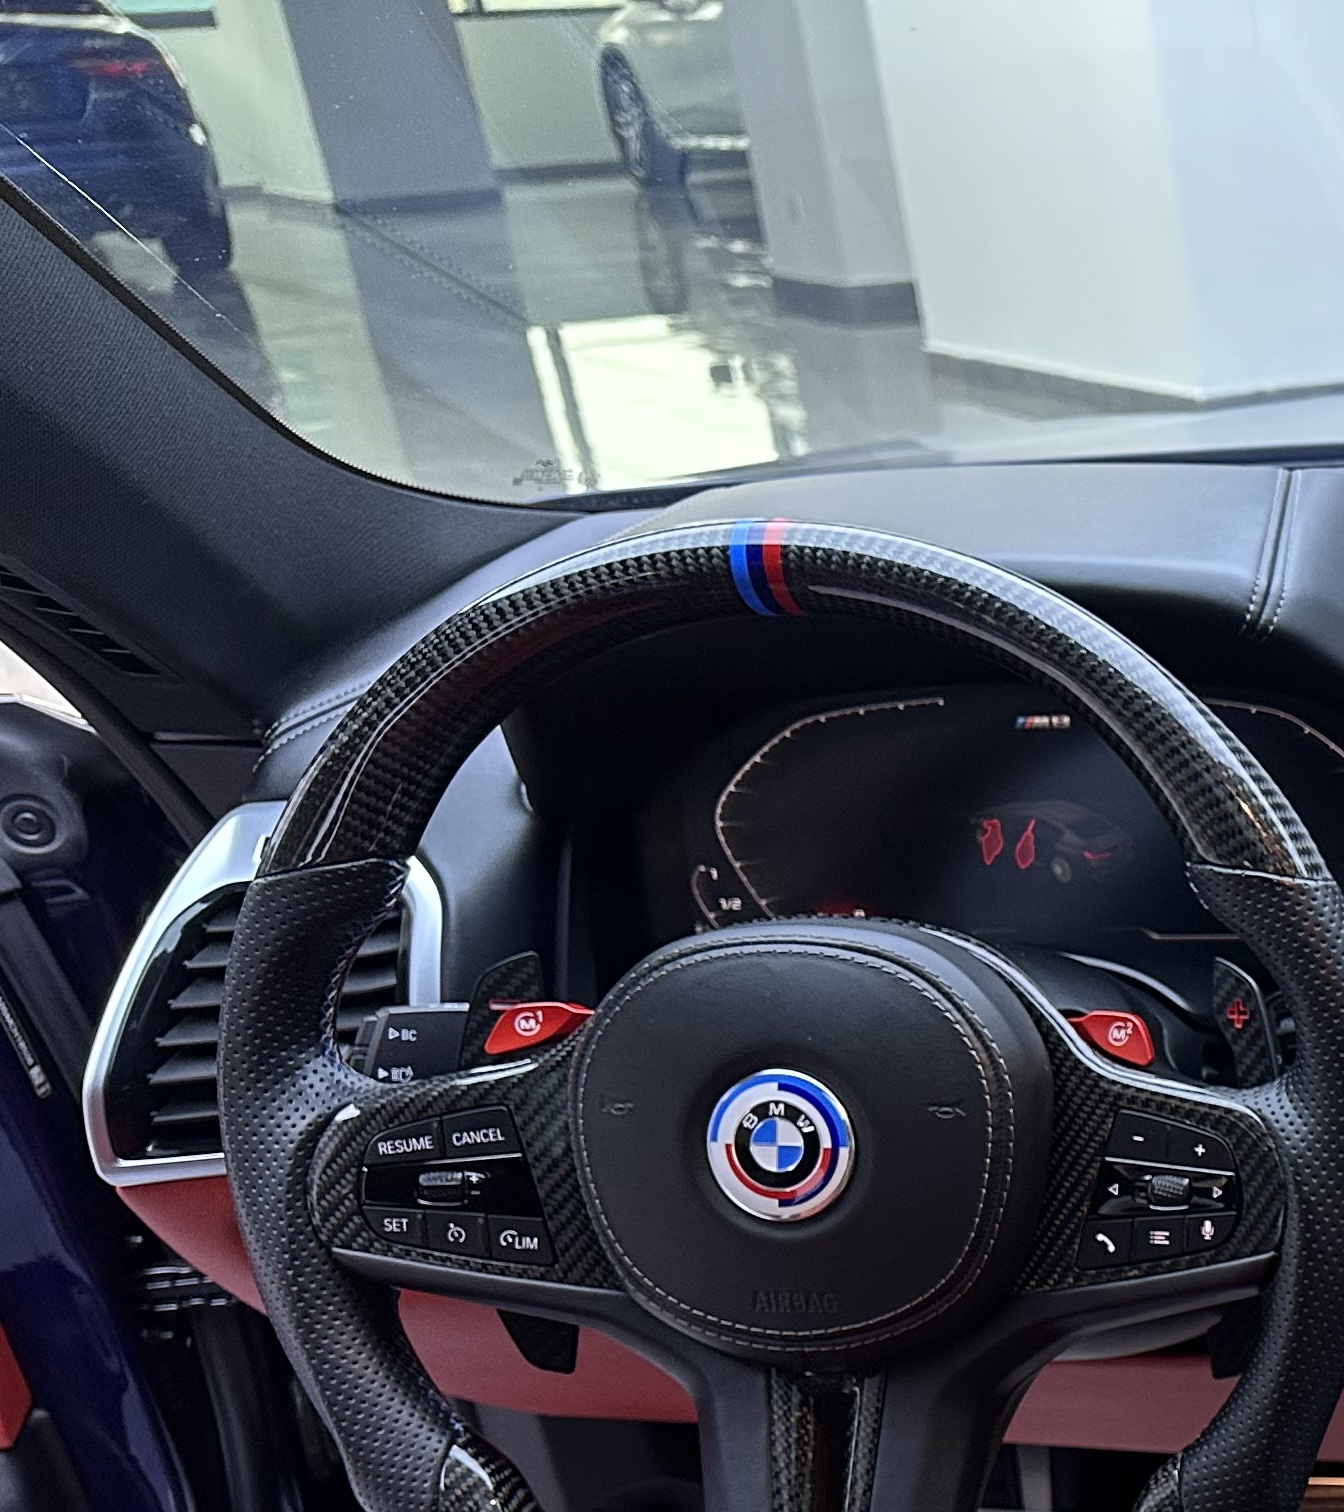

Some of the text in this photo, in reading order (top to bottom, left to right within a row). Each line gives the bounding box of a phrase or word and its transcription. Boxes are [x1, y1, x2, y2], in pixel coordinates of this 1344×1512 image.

[742, 1102, 815, 1133] BMW
[377, 1135, 435, 1156] RESUME
[452, 1127, 505, 1147] CANCEL
[383, 1218, 409, 1233] SET
[515, 1236, 538, 1250] LIM
